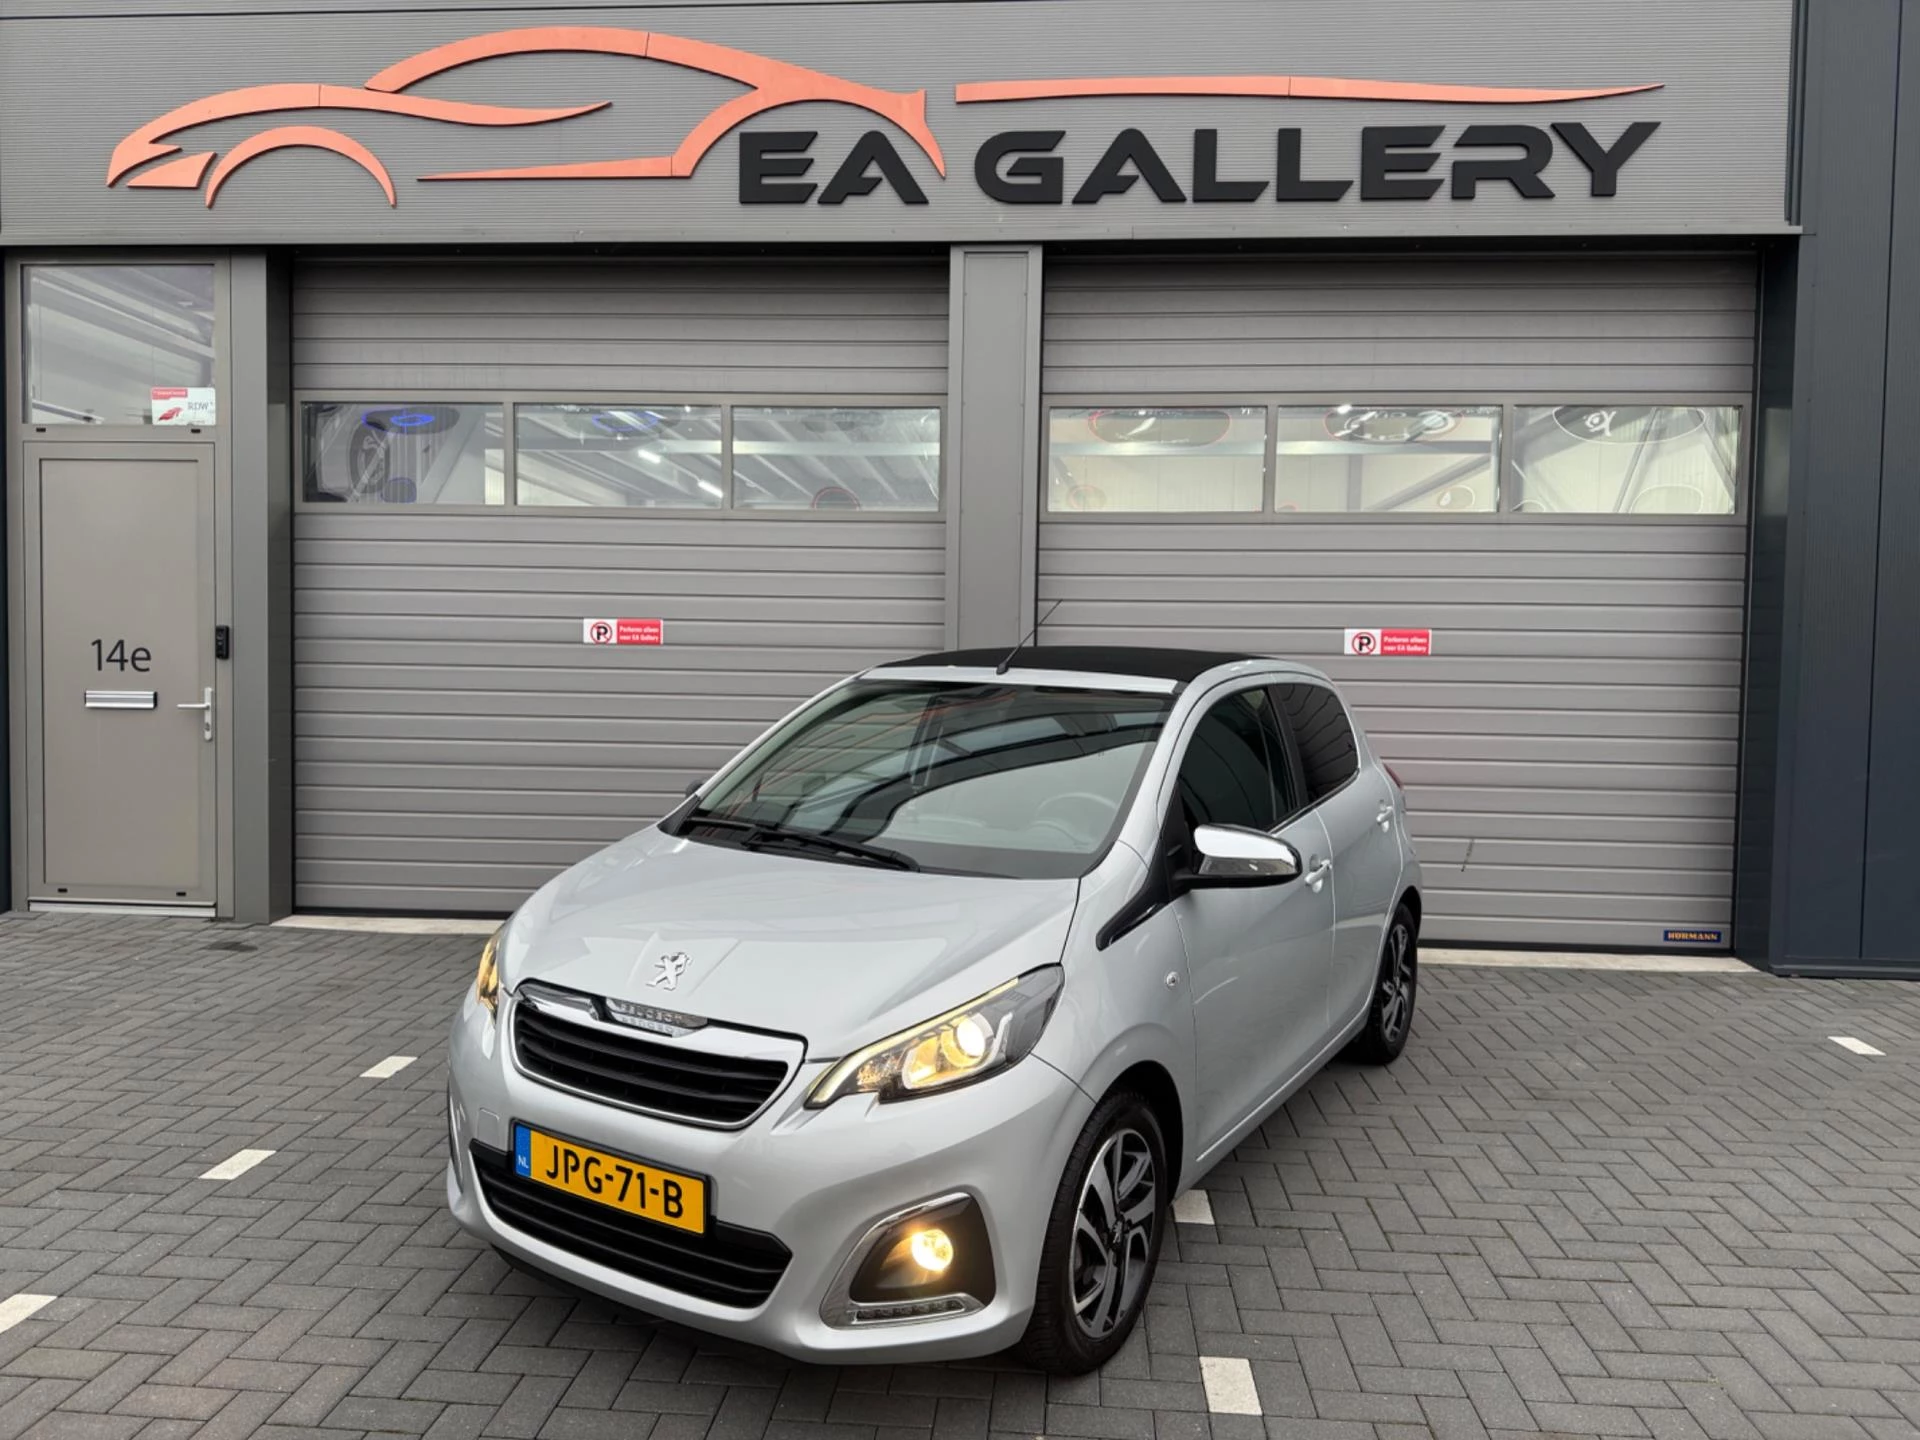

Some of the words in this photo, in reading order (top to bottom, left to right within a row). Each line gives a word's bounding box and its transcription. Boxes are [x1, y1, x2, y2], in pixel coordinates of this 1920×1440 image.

[739, 130, 929, 205] EA
[974, 121, 1661, 205] GALLERY
[596, 625, 608, 640] P
[1358, 635, 1371, 651] P
[91, 638, 151, 672] 14e
[518, 1155, 529, 1169] NL
[546, 1145, 683, 1219] JPG-71-B
